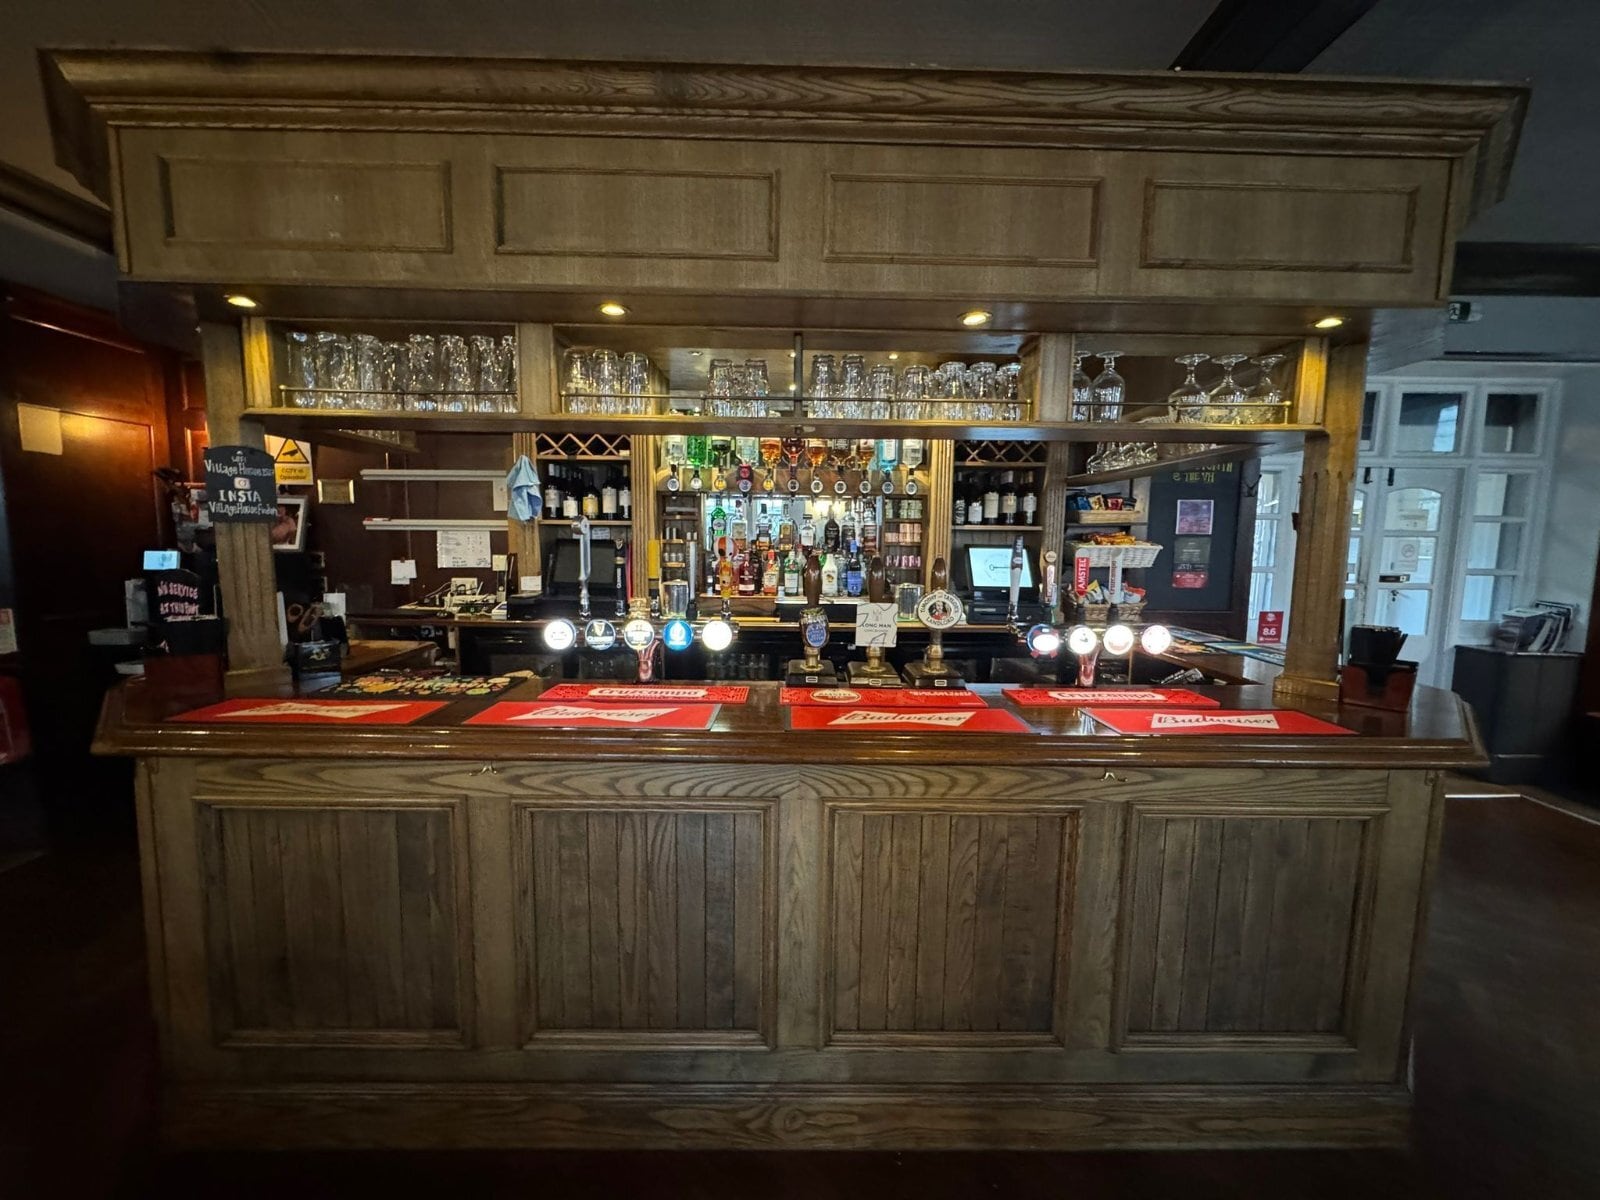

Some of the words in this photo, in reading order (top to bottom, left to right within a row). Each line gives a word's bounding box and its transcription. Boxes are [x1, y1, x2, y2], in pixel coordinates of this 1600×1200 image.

[219, 490, 261, 502] INSTA
[1078, 558, 1087, 589] AMSTEL
[169, 583, 198, 599] SERVICE
[847, 711, 968, 722] Budweiser
[1157, 715, 1275, 725] Budweiser
